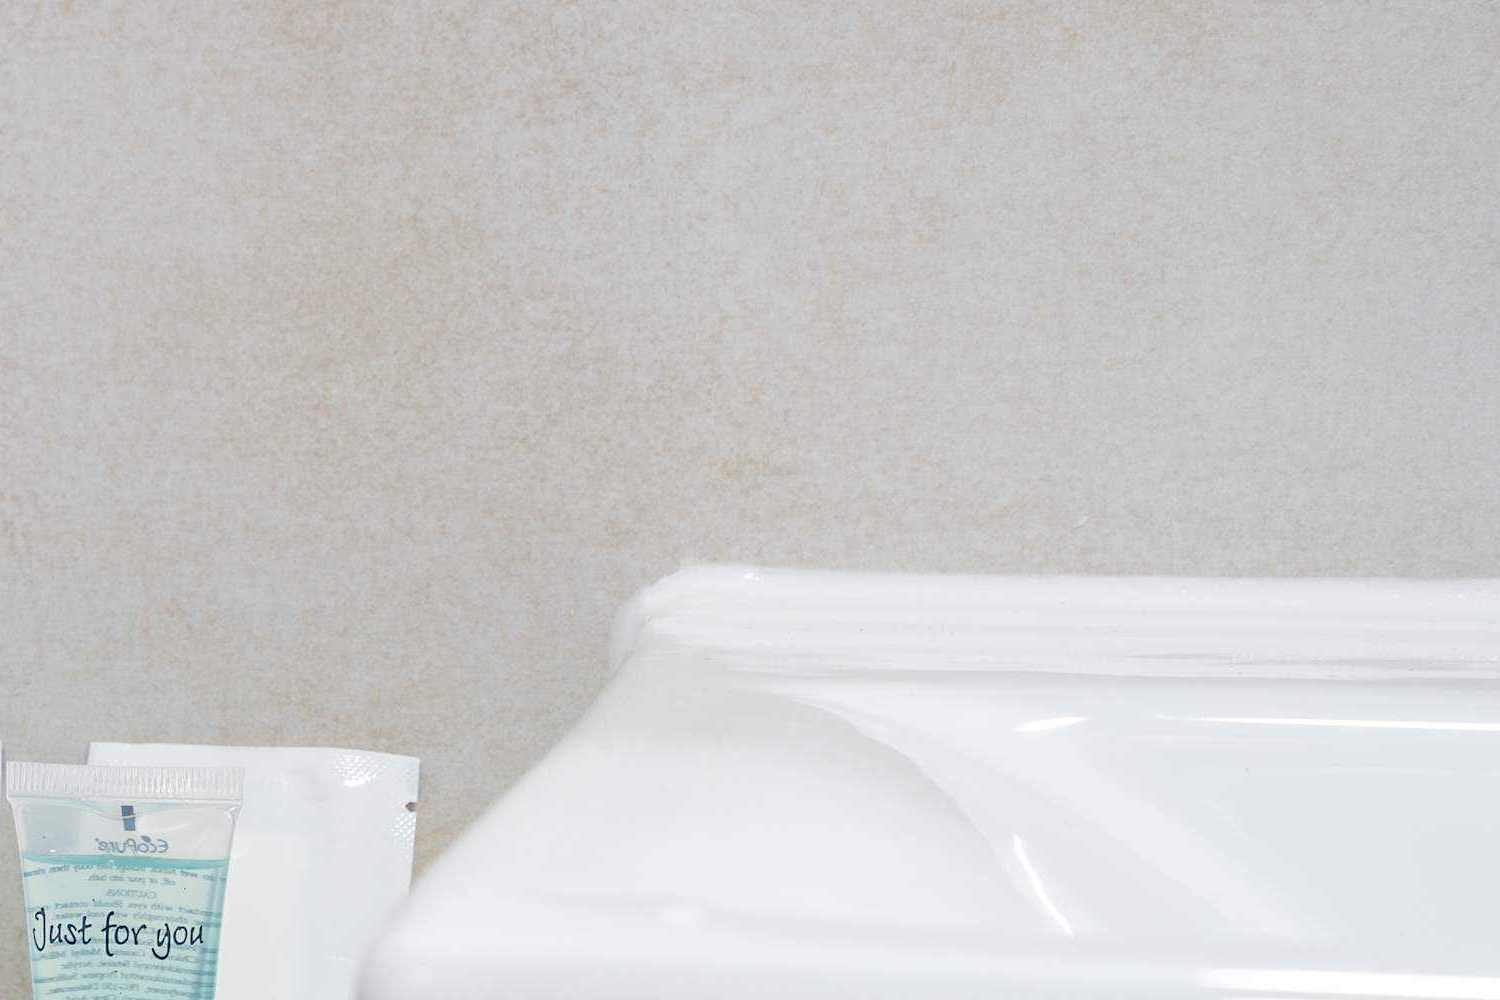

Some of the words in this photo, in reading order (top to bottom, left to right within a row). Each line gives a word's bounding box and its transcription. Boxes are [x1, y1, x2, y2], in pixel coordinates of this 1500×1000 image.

[32, 907, 93, 953] Just
[101, 911, 148, 957] for
[151, 922, 205, 961] you
